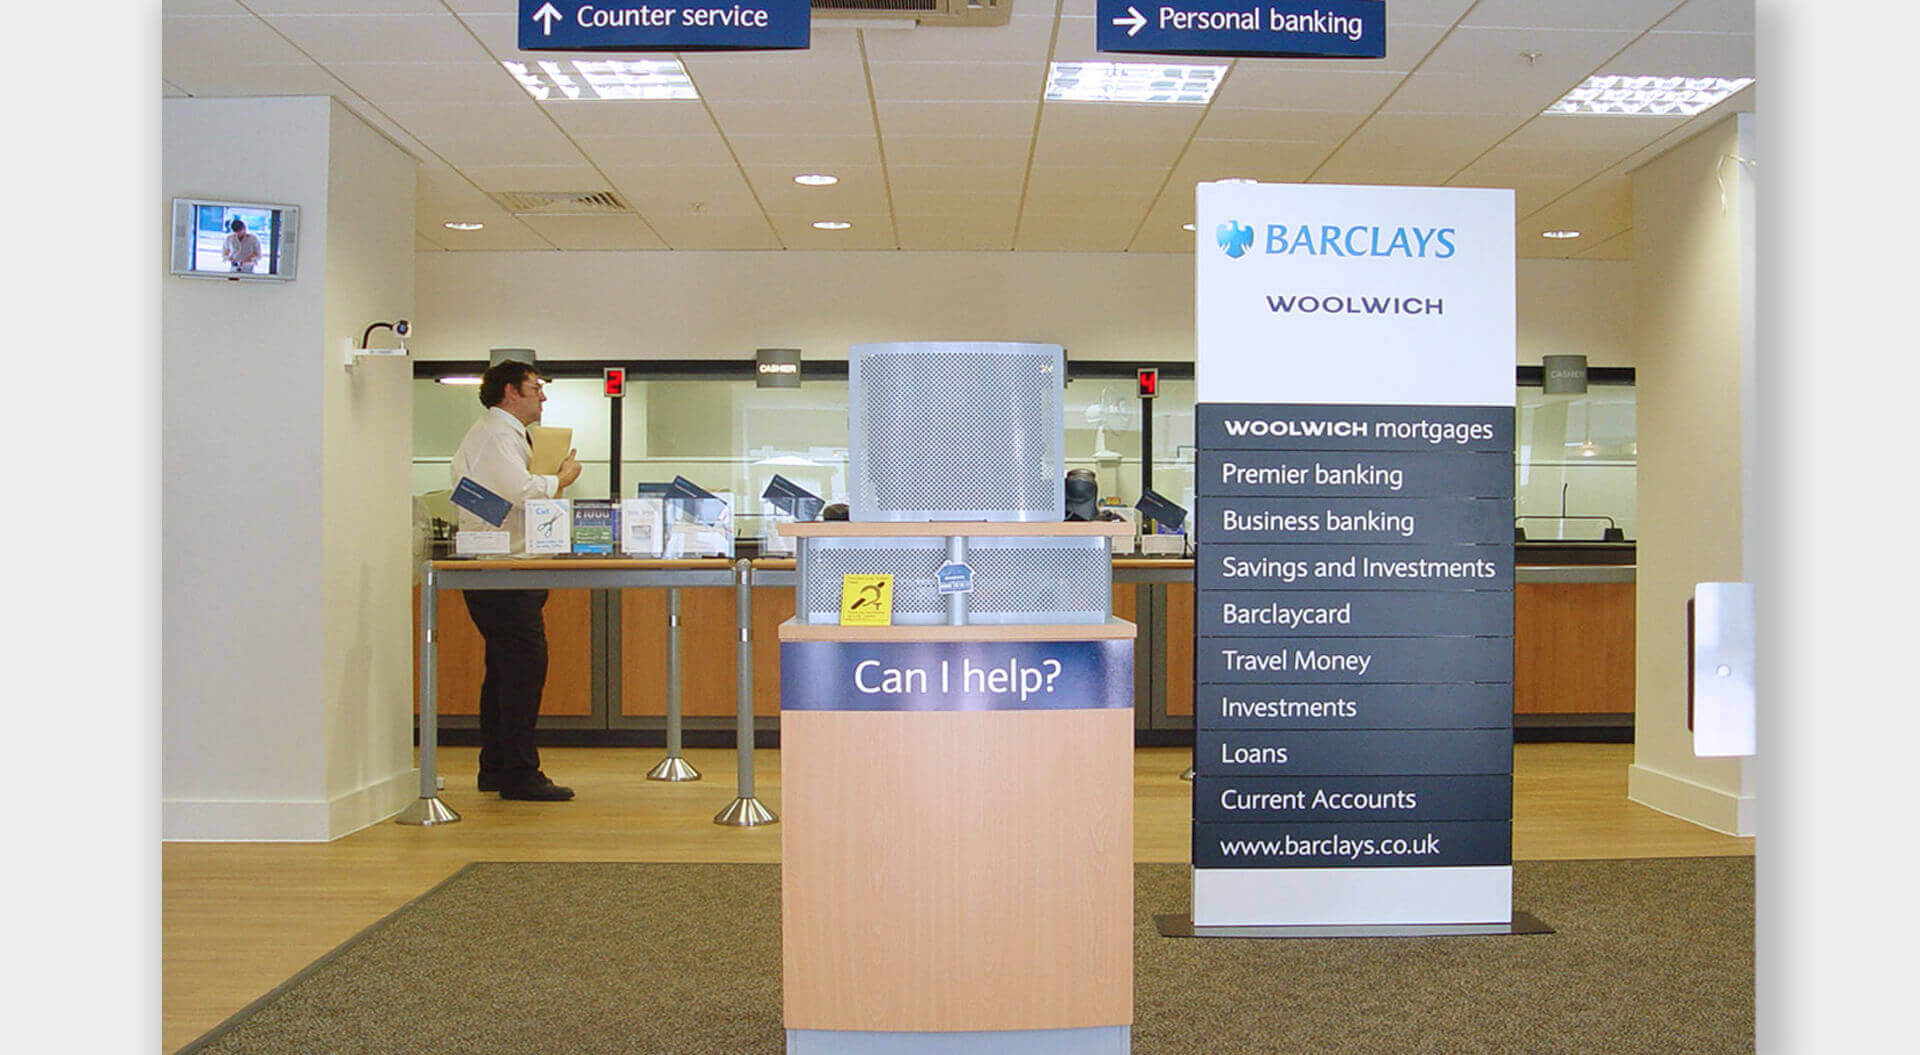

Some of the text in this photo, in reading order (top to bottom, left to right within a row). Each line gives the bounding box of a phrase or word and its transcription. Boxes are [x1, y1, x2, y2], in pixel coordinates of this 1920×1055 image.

[577, 5, 769, 28] Counter service
[1159, 6, 1363, 41] Personal banking
[1264, 224, 1456, 259] BARCLAYS
[1266, 295, 1444, 315] WOOLWICH
[1140, 372, 1155, 393] 4
[1224, 419, 1494, 444] WOOLWICH mortgages
[1222, 463, 1403, 491] Premier banking
[1223, 509, 1415, 537] Business banking
[1222, 556, 1496, 583] Savings and Investments
[1223, 602, 1351, 629] Barclaycard
[1221, 649, 1372, 675] Travel Money
[855, 658, 1062, 701] Can I help?
[1222, 697, 1357, 718] Investments
[1221, 743, 1288, 764] Loans
[1221, 789, 1417, 810] Current Accounts
[1220, 833, 1440, 860] www.barclays.co.uk
